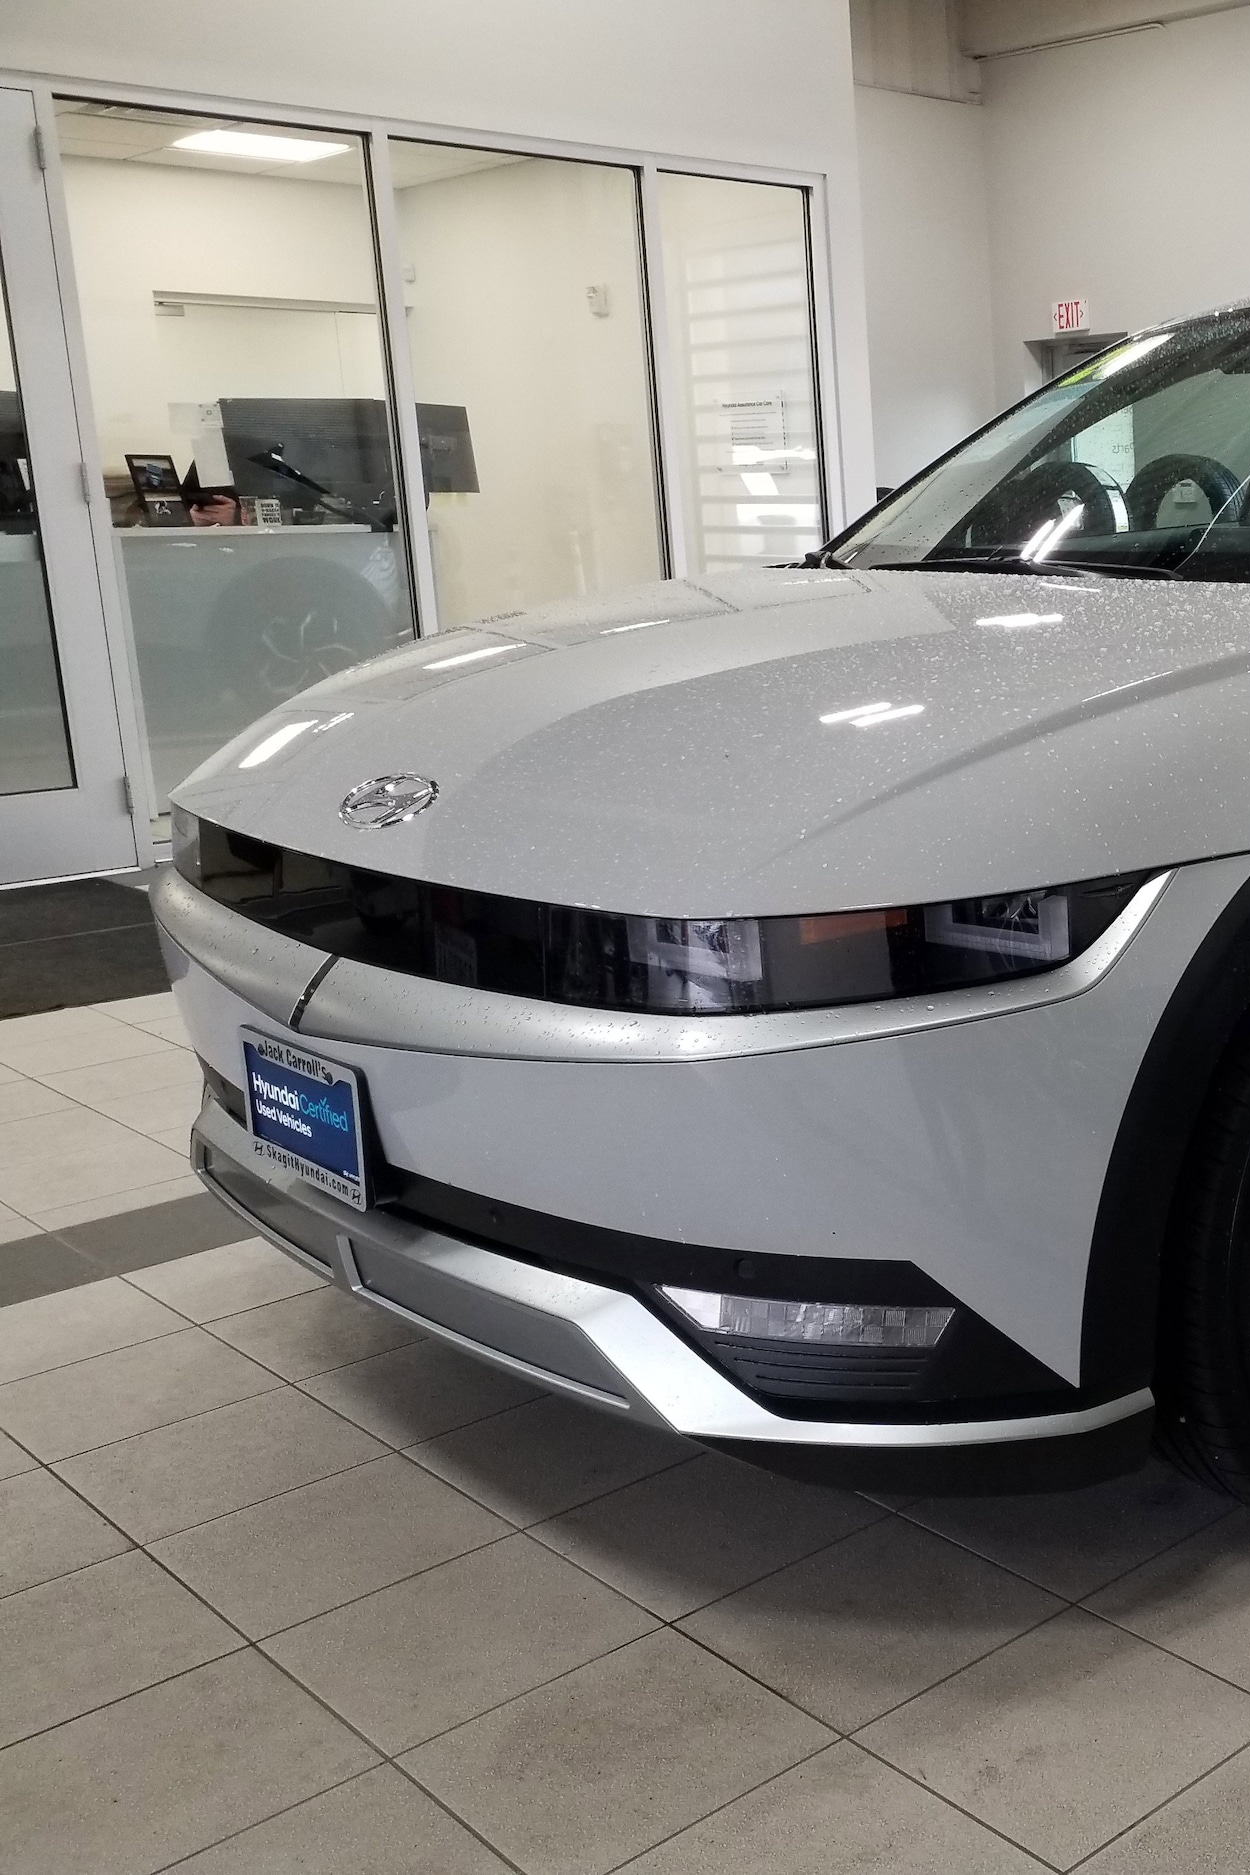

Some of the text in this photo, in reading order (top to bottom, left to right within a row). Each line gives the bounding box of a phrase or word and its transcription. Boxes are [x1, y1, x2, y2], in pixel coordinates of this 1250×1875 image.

[1057, 301, 1080, 330] EXIT
[264, 1040, 327, 1080] Jack Carroll's
[252, 1071, 349, 1132] Hyundai Certified
[256, 1099, 312, 1138] Used Vehicles
[266, 1144, 349, 1197] SkagitHyundai.com
